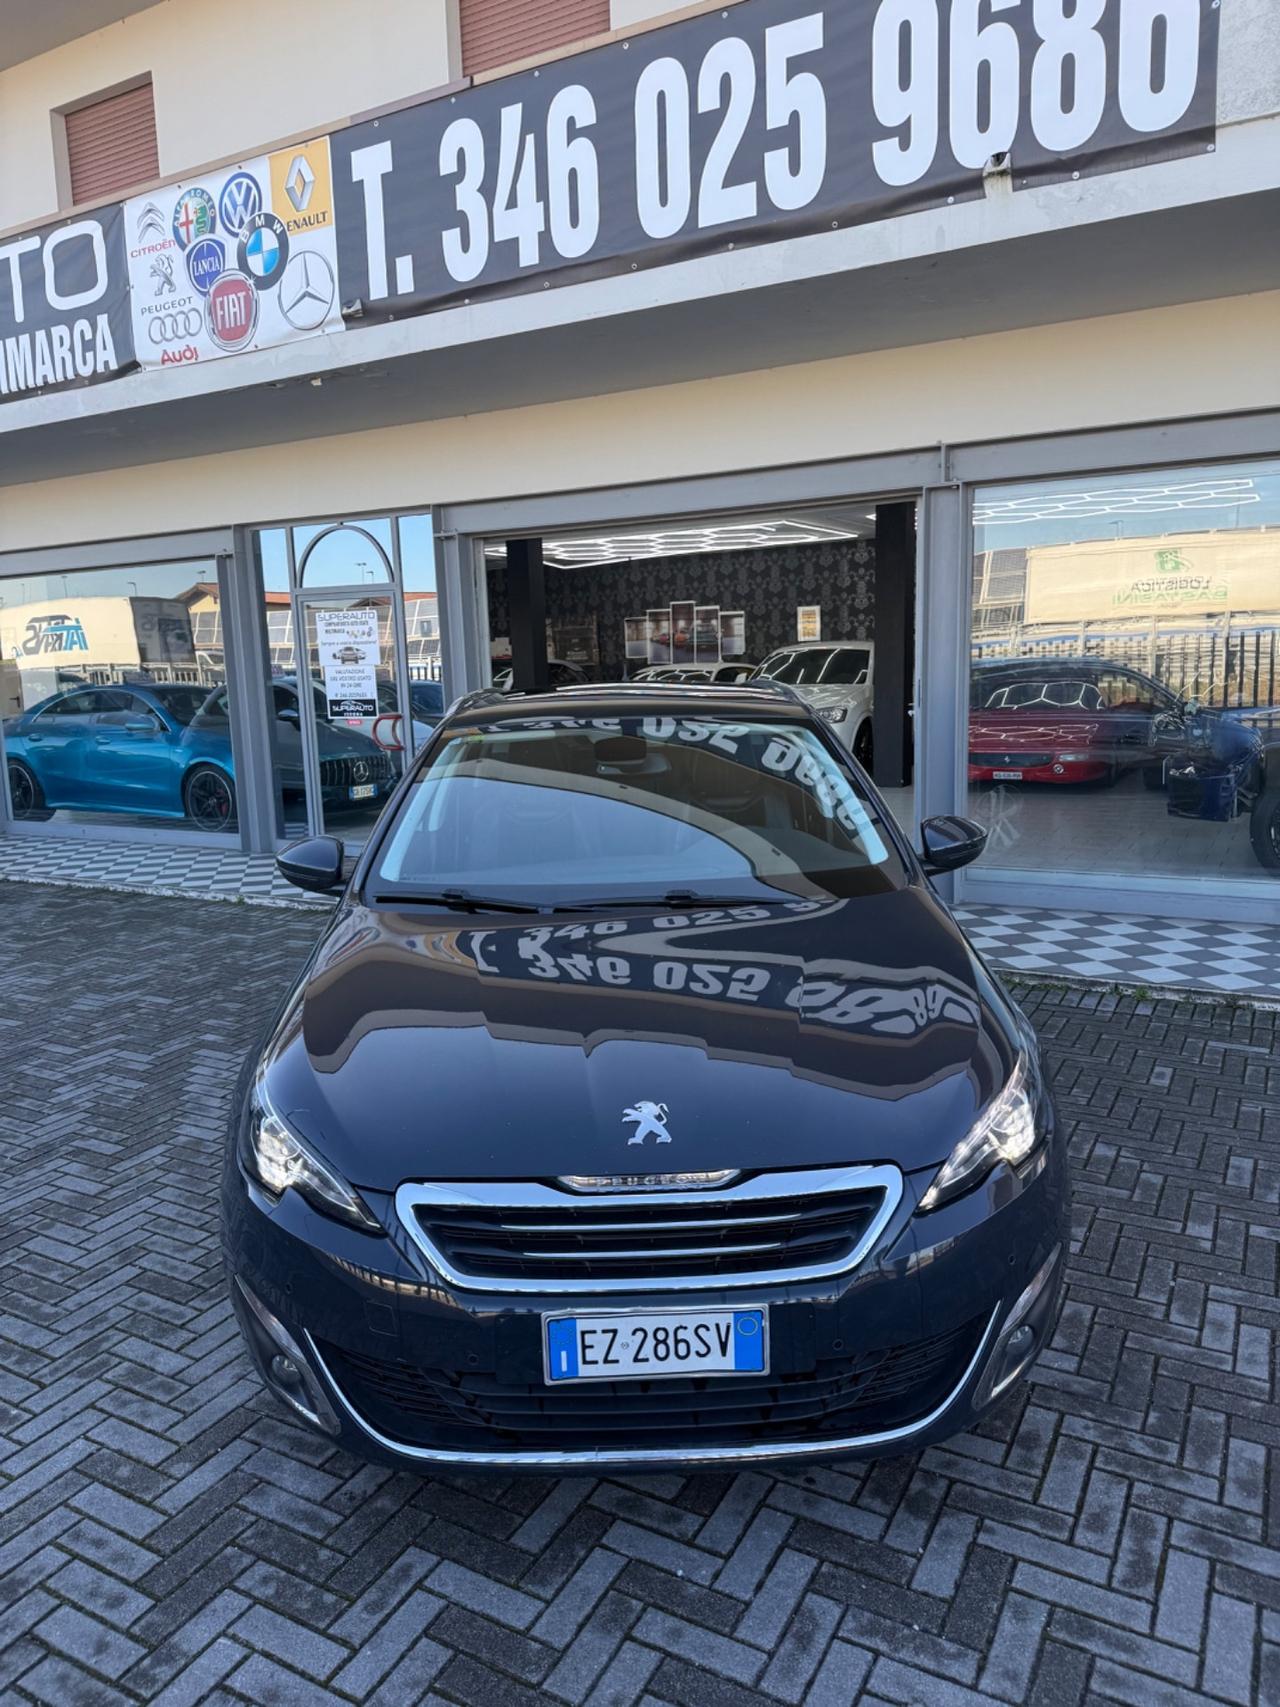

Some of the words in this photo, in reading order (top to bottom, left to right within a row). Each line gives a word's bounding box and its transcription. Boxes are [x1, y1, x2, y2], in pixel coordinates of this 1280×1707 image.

[351, 140, 414, 300] T.
[439, 84, 600, 283] 346
[634, 12, 827, 239] 025
[286, 211, 328, 233] ENAULT
[193, 256, 221, 277] LANCIA
[140, 296, 193, 316] PEUGEOT
[215, 291, 248, 332] FIAT
[160, 345, 199, 365] Audi
[317, 611, 376, 622] SUPERAUTO
[580, 1328, 620, 1366] EZ
[631, 1322, 732, 1364] 286SV
